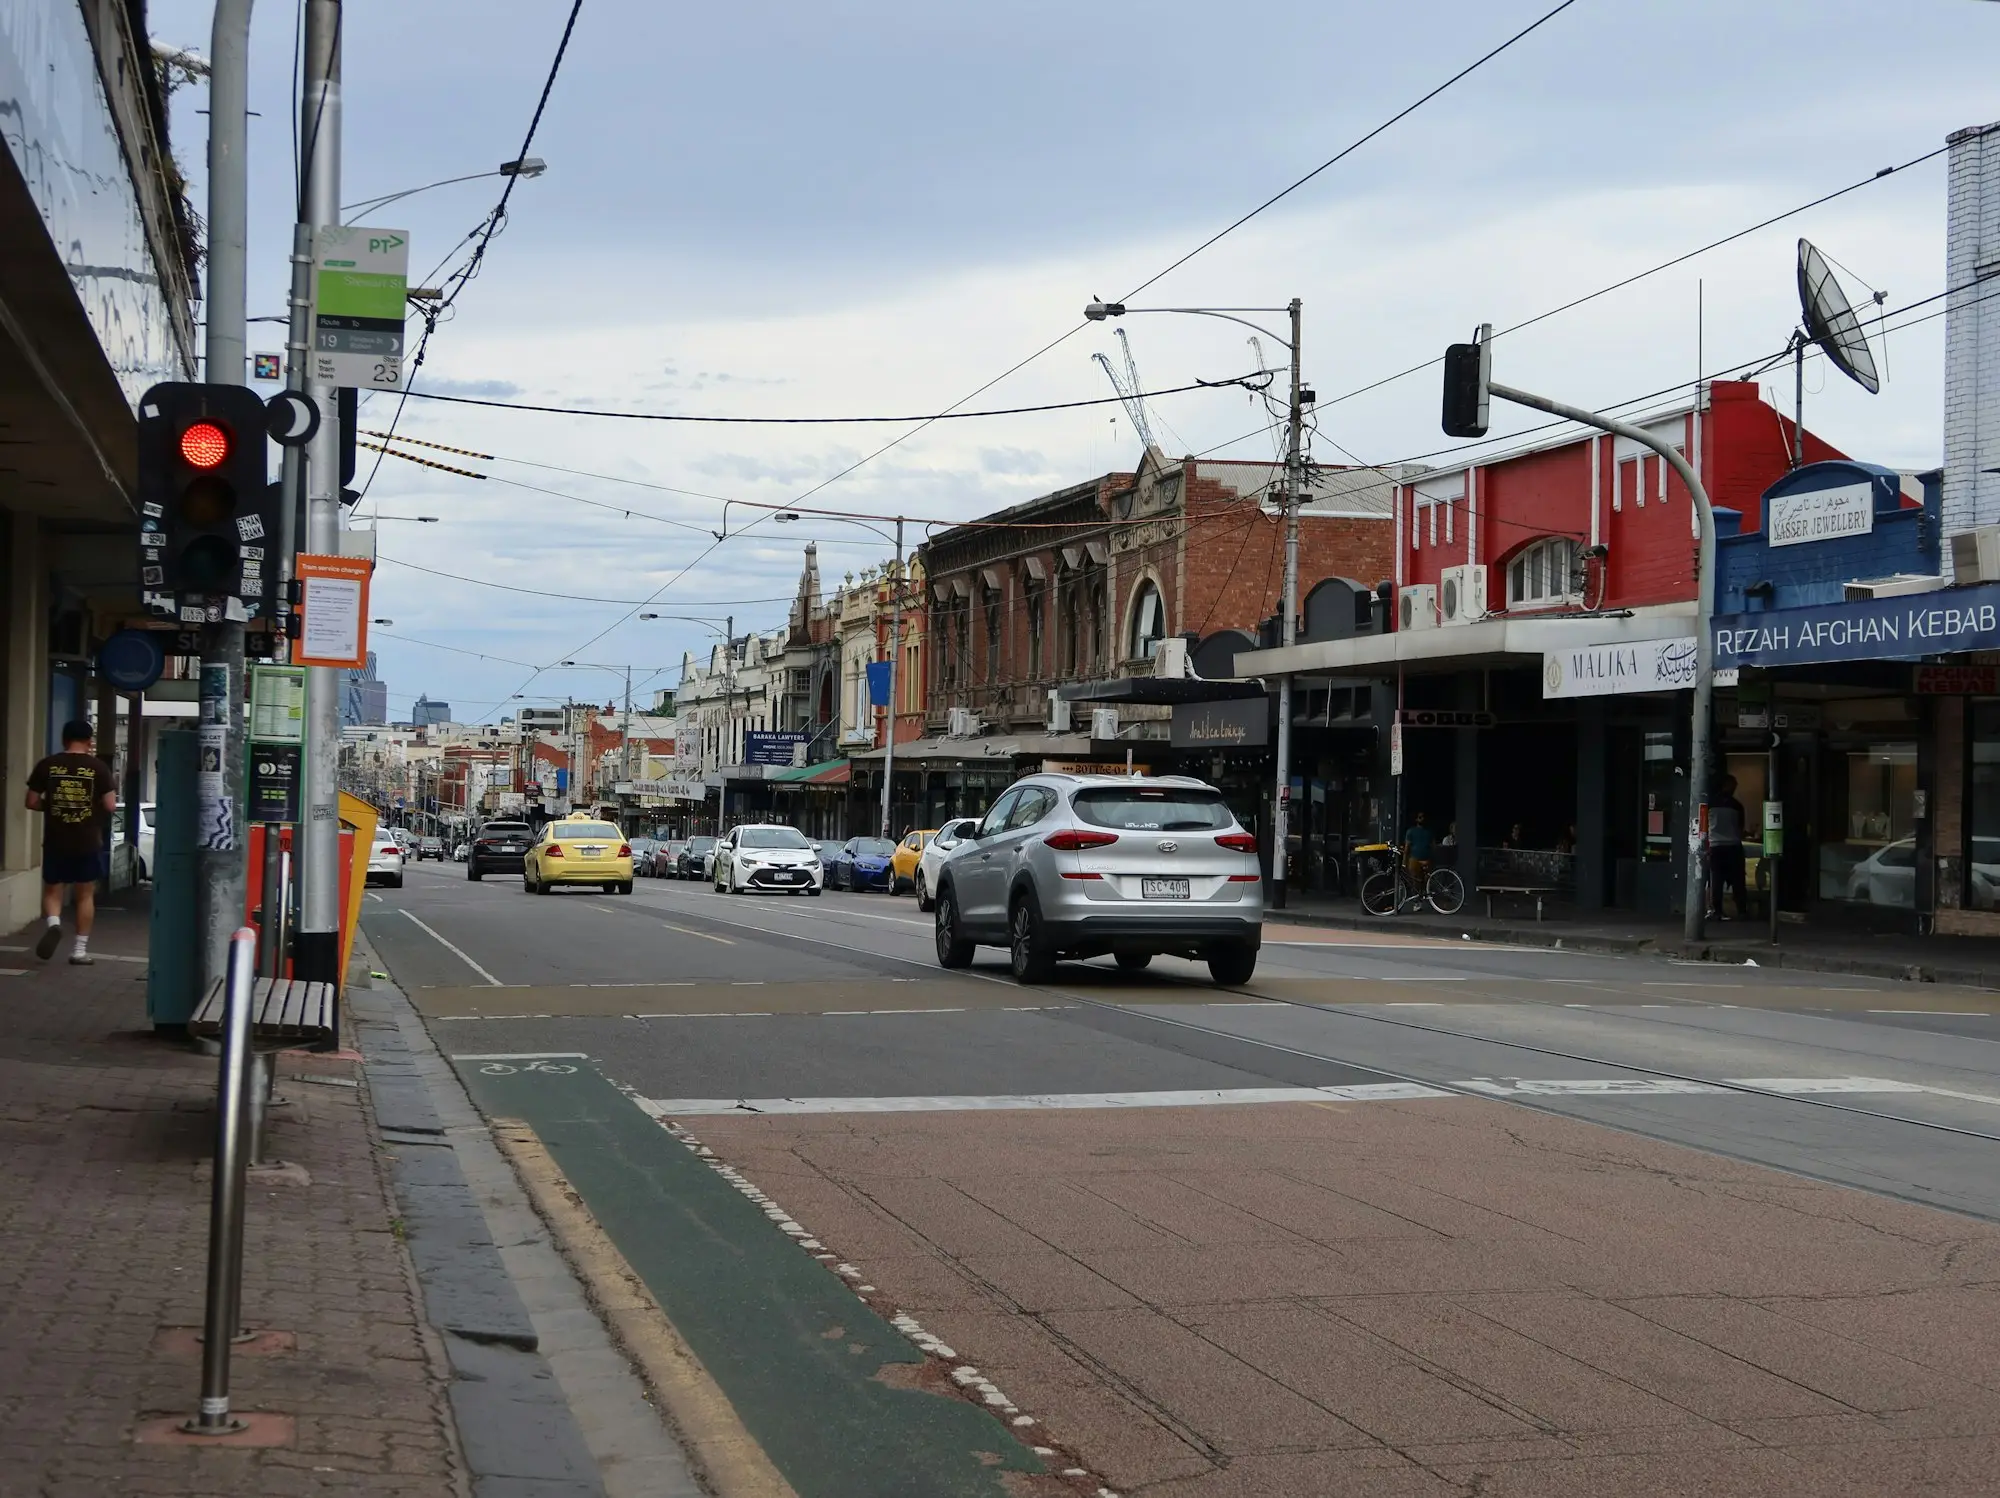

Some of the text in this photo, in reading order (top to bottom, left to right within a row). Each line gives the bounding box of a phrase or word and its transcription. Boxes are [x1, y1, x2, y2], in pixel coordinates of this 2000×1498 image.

[320, 335, 338, 348] 19
[383, 355, 399, 363] Stop
[238, 515, 261, 529] ETHAN
[1773, 510, 1867, 541] NASSER JEWELLERY
[241, 525, 264, 540] FRANK
[301, 563, 367, 576] Tram service changes
[1716, 604, 1997, 656] REZAH AFGHAN KEBAB
[1573, 649, 1638, 679] MALIKA
[1918, 680, 1995, 692] KEBAB
